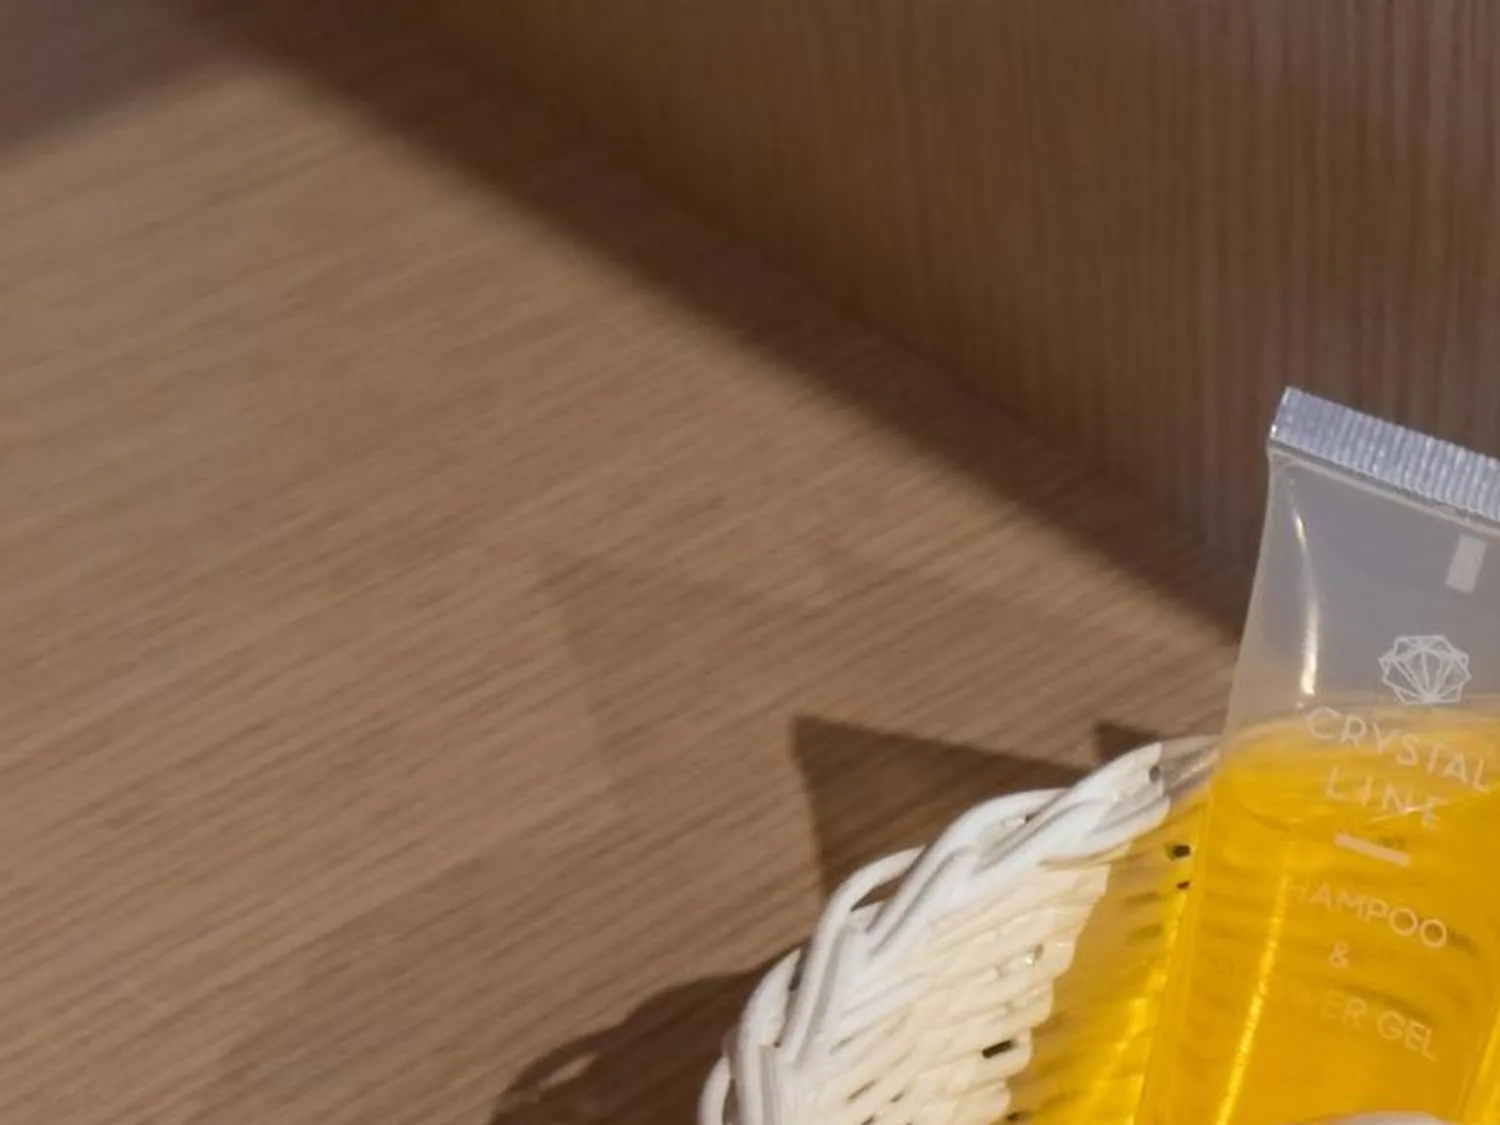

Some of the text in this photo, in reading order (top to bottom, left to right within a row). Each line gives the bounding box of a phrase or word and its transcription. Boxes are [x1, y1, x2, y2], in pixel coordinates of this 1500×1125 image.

[1305, 706, 1492, 795] CRYSTAL
[1325, 764, 1449, 831] LINE
[1328, 940, 1350, 970] &
[1376, 1009, 1437, 1062] GEL
